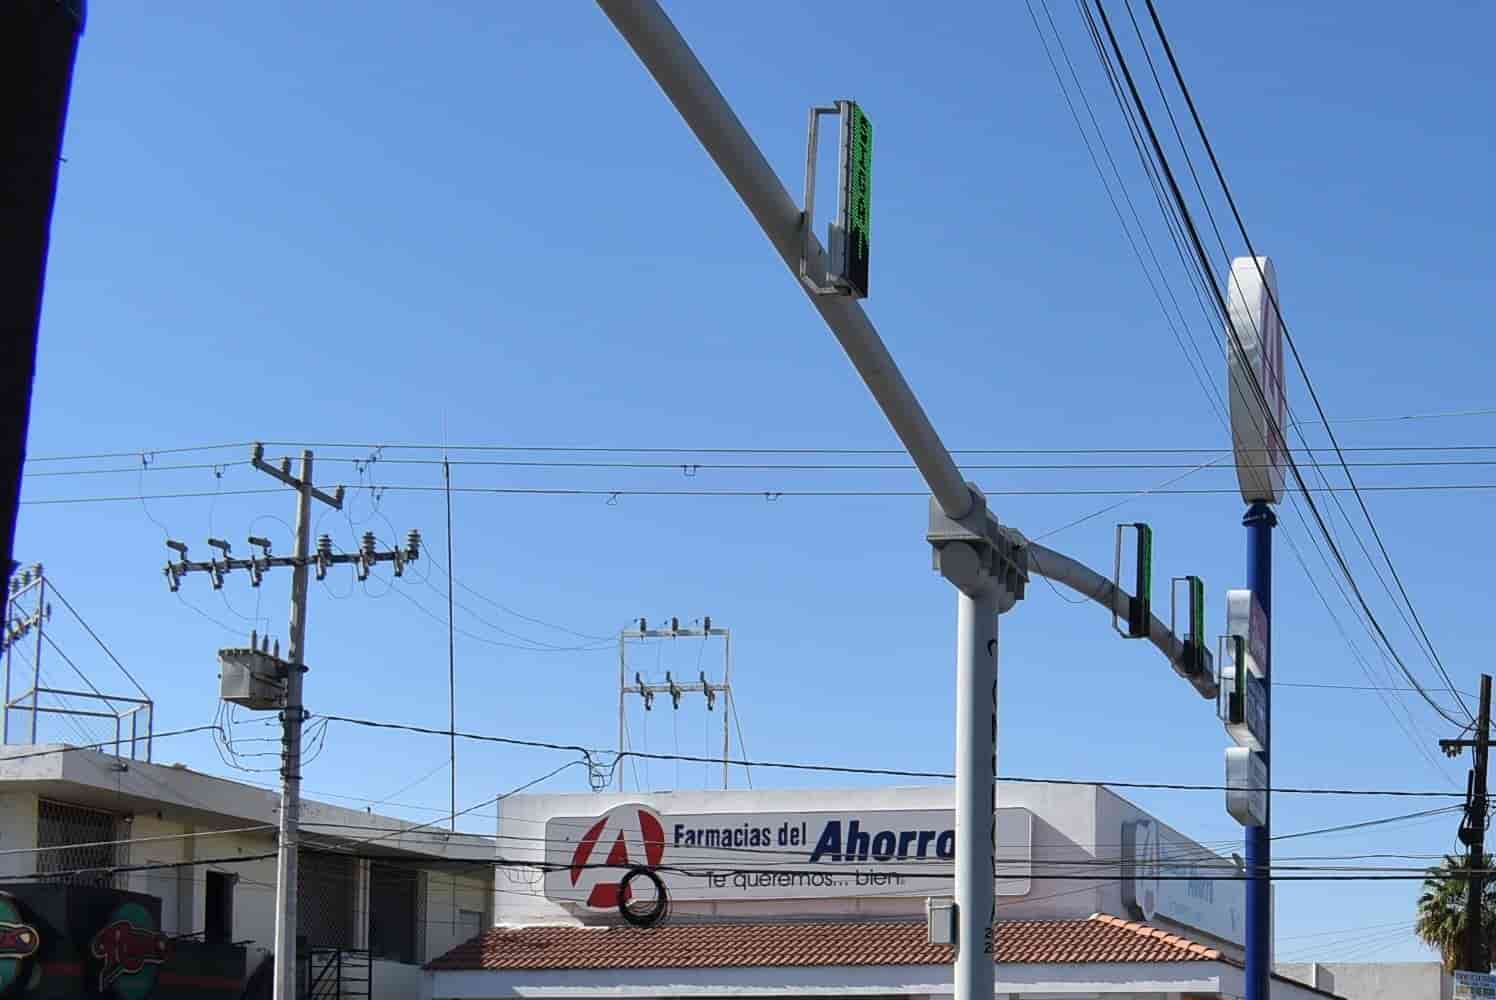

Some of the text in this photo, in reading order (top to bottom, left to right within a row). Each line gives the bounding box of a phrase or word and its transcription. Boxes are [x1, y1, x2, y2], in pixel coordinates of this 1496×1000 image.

[674, 819, 955, 864] Farmacias del Ahorro
[707, 868, 905, 891] Te queremos... bien.
